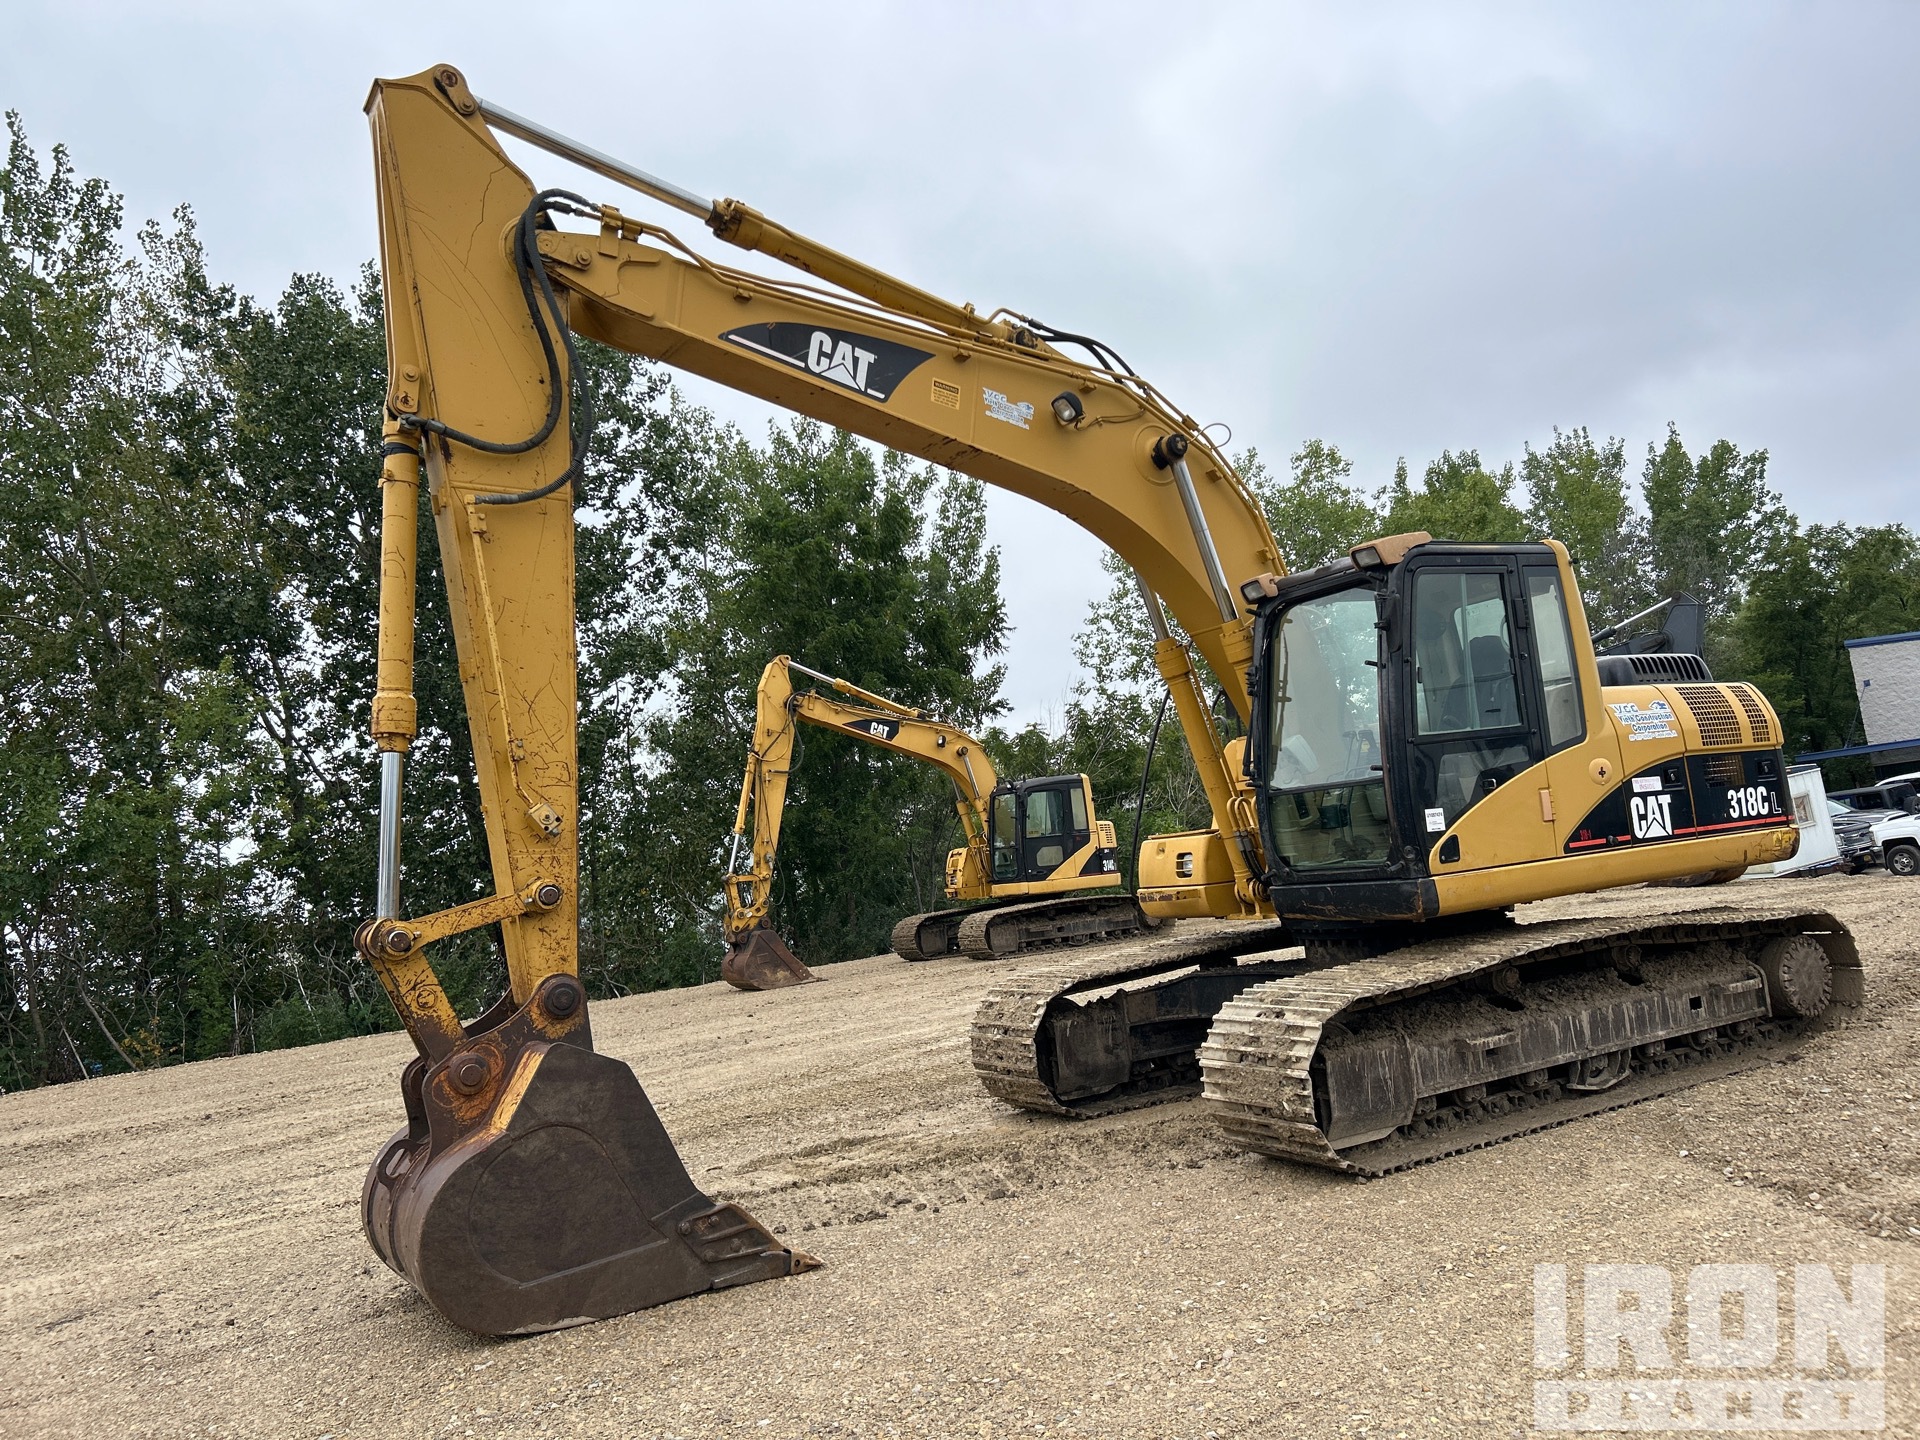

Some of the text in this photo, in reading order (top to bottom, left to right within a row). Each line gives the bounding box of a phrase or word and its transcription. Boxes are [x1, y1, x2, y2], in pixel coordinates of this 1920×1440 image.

[807, 331, 876, 392] CAT
[1632, 723, 1668, 732] Corporation
[1636, 713, 1673, 722] Construction
[870, 722, 890, 739] CAT
[1728, 786, 1782, 819] 318C L
[1630, 794, 1673, 839] CAT
